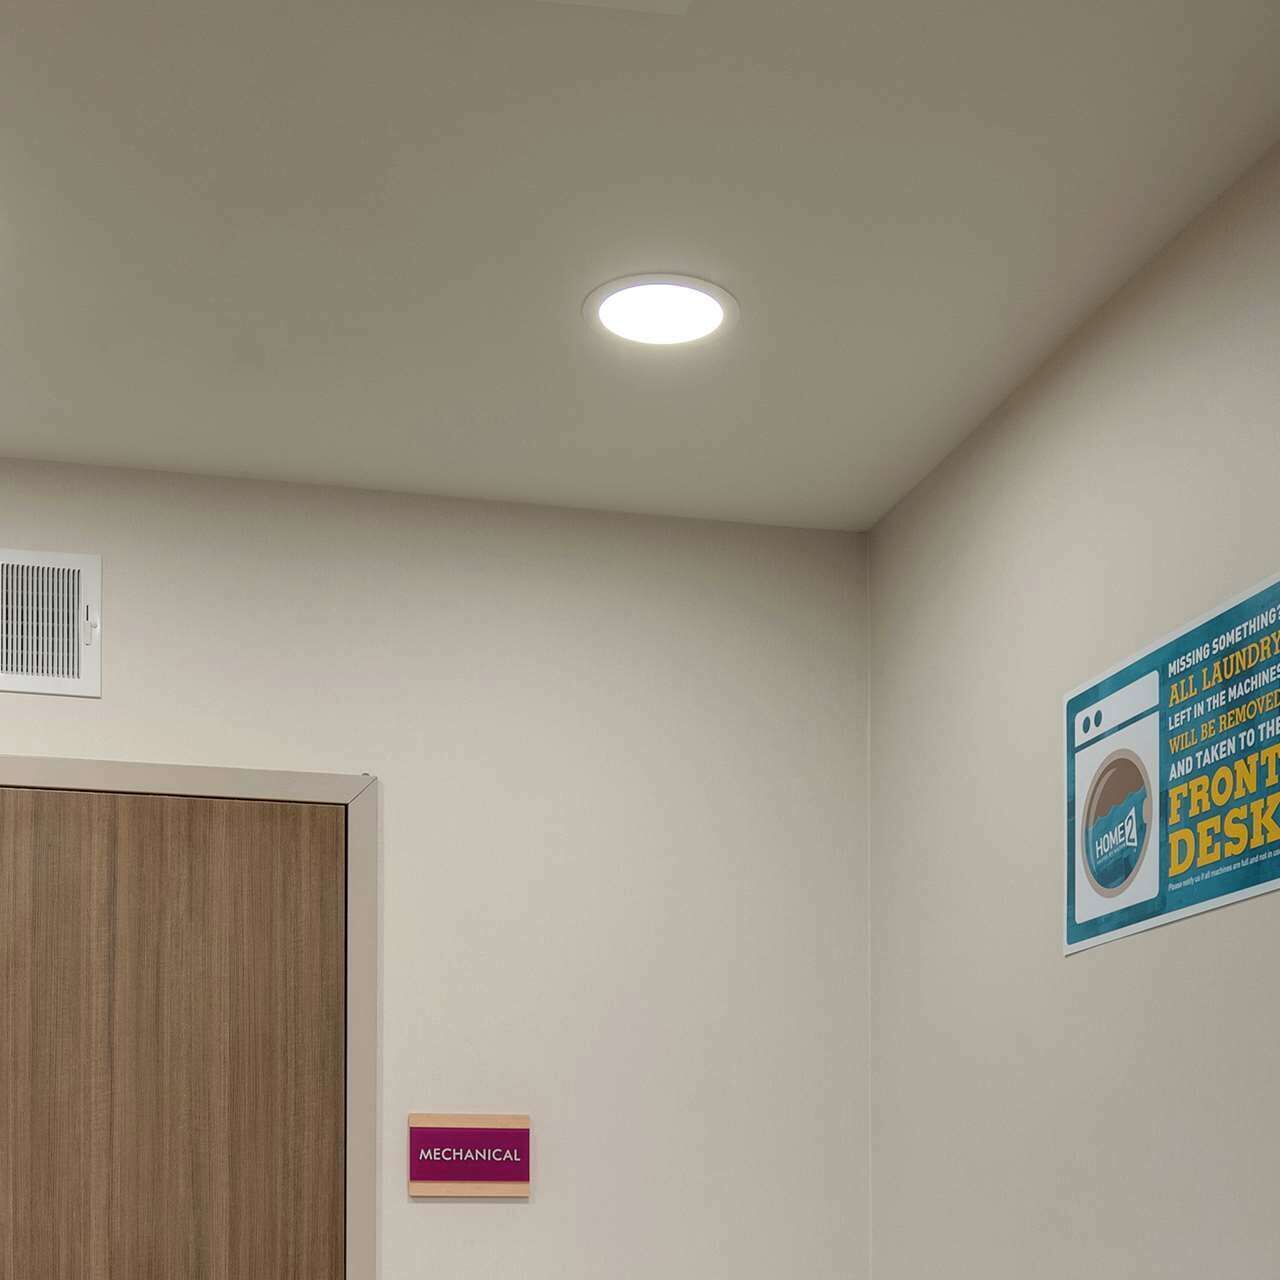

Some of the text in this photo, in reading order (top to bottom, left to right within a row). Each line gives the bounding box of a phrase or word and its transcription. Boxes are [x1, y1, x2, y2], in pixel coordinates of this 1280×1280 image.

[1168, 643, 1210, 678] MISSING
[1168, 674, 1197, 708] ALL
[1168, 706, 1193, 731] LEFT
[1193, 701, 1204, 719] IN
[1206, 690, 1226, 712] THE
[1168, 728, 1198, 754] WILL
[1200, 719, 1216, 741] BE
[1168, 756, 1193, 782] AND
[1195, 736, 1236, 769] TAKEN
[1238, 728, 1255, 750] TO
[419, 1147, 521, 1161] MECHANICAL
